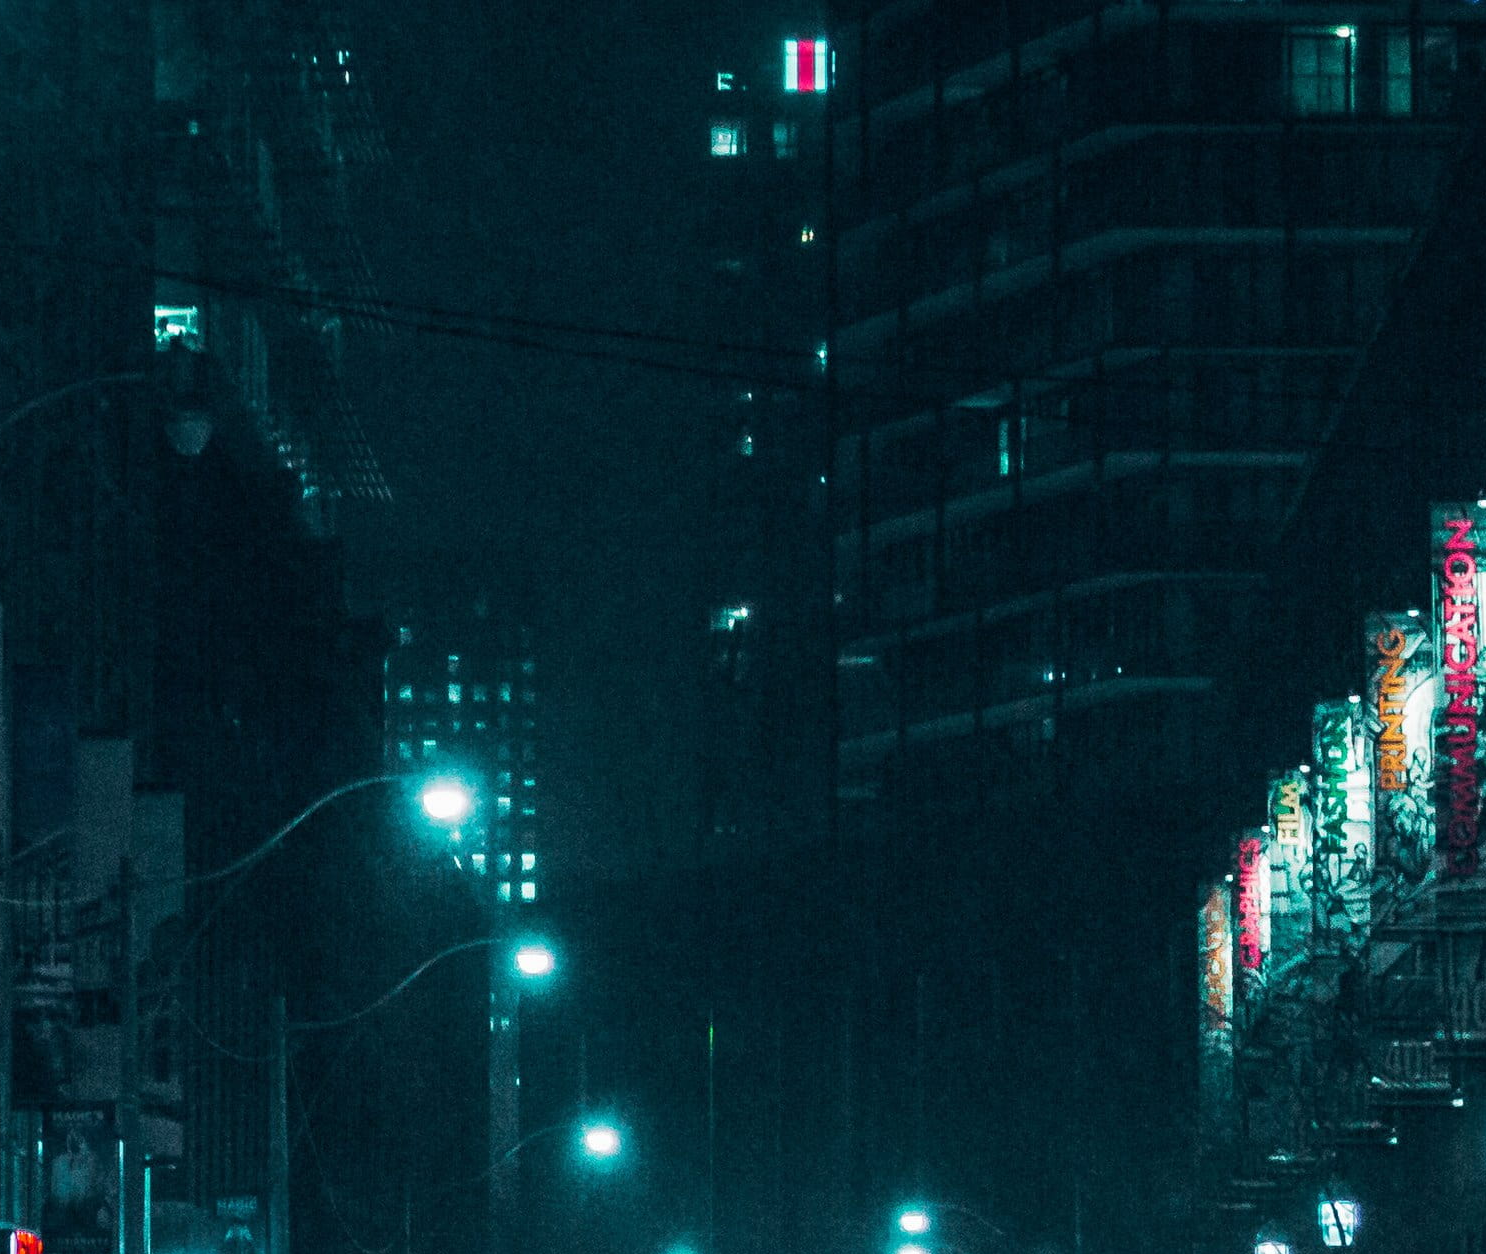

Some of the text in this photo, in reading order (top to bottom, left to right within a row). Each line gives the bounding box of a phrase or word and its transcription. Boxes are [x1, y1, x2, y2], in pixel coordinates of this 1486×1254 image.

[1377, 628, 1407, 790] PRINTING
[1444, 519, 1478, 875] COMMUNICATION
[1277, 780, 1300, 845] FILM
[1320, 718, 1347, 855] FASHION
[1239, 838, 1261, 969] GRAPHICS
